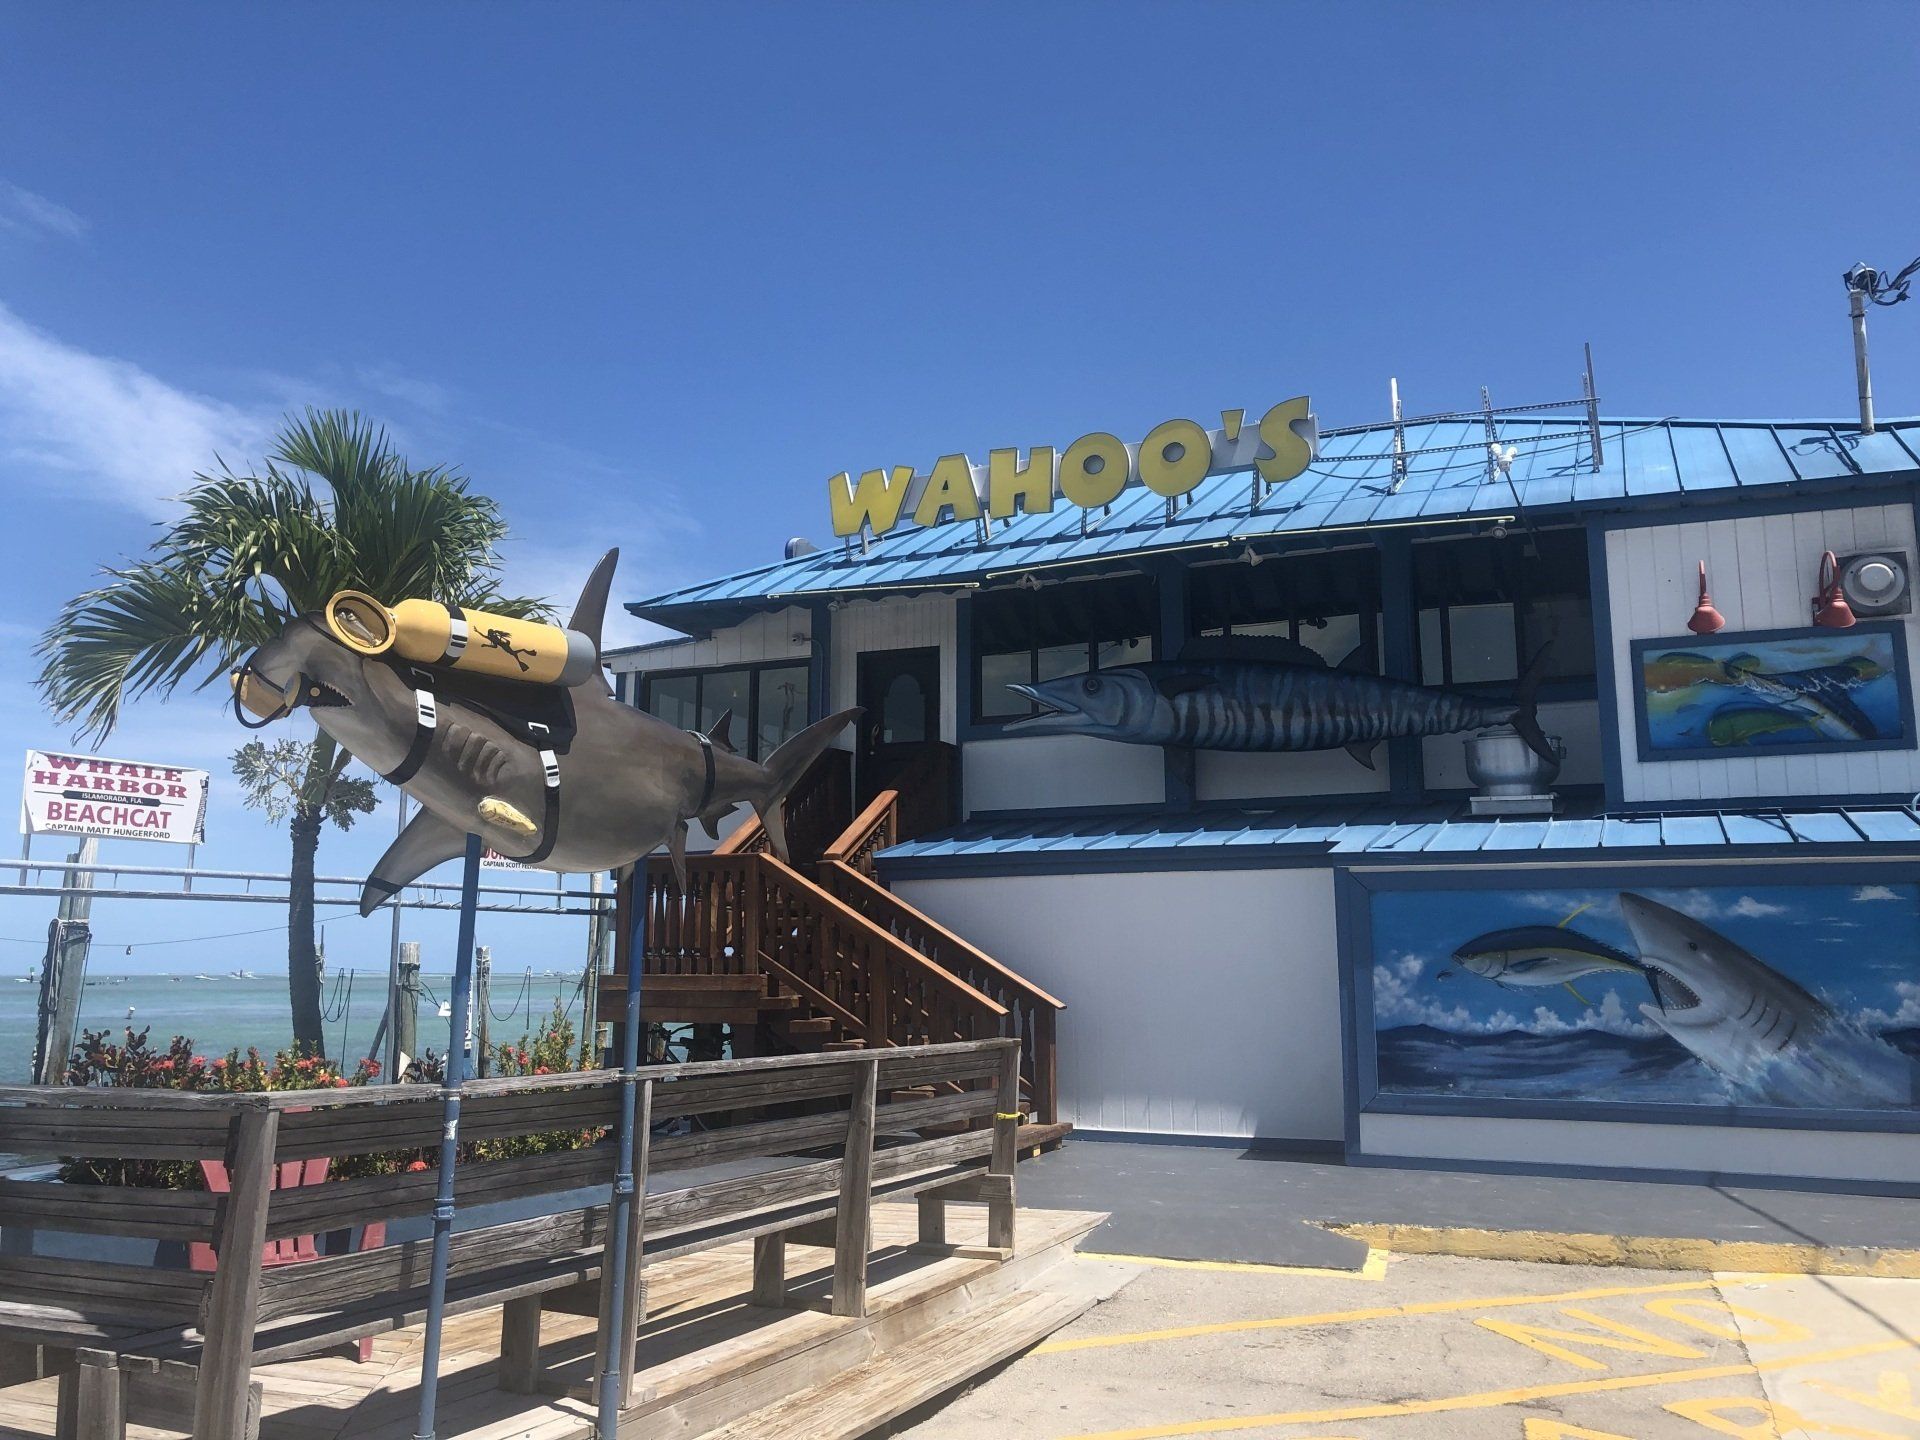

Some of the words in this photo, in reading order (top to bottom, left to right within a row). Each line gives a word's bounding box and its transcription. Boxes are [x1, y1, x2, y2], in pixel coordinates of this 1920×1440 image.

[828, 395, 1312, 538] WAHOO'S
[47, 755, 182, 783] WHALE
[32, 770, 188, 798] HARBOR
[81, 792, 128, 803] ISLAMORADA,
[130, 796, 144, 804] FLA.
[47, 801, 172, 829] BEACHCAT
[86, 826, 111, 835] MATT
[113, 828, 171, 839] HUNGERFORD
[483, 860, 504, 868] CAPTAIN
[1473, 1299, 1814, 1370] NO
